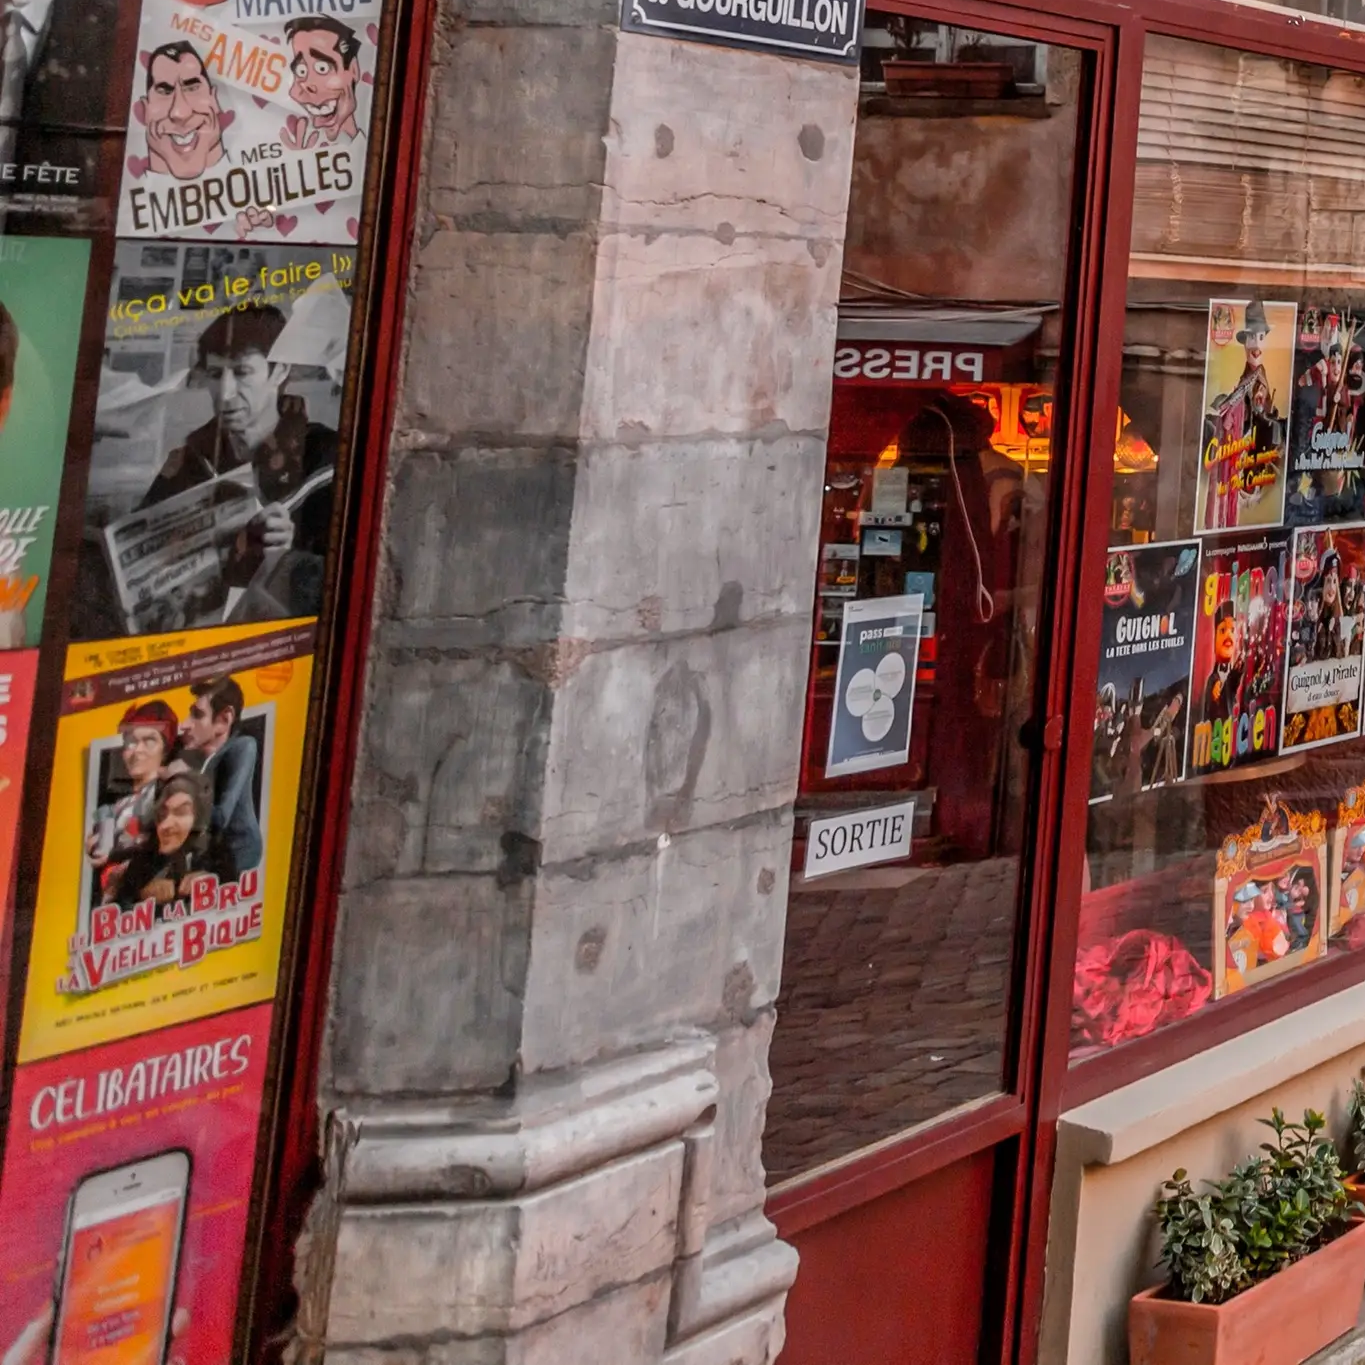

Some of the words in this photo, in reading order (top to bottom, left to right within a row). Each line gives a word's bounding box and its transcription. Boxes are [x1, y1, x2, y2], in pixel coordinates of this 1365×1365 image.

[170, 13, 215, 42] MES
[241, 142, 282, 165] MES
[23, 160, 81, 185] FÊTE
[177, 286, 215, 306] va
[224, 275, 251, 299] le
[259, 261, 322, 288] faire
[860, 628, 883, 645] pass
[1116, 613, 1177, 643] GUIGNOL
[1291, 668, 1323, 692] Guignol
[1333, 664, 1358, 683] Pirate
[816, 815, 904, 859] SORTIE
[192, 870, 257, 911] BRU
[82, 930, 175, 986] VIEILLE
[180, 902, 262, 965] BIQUE
